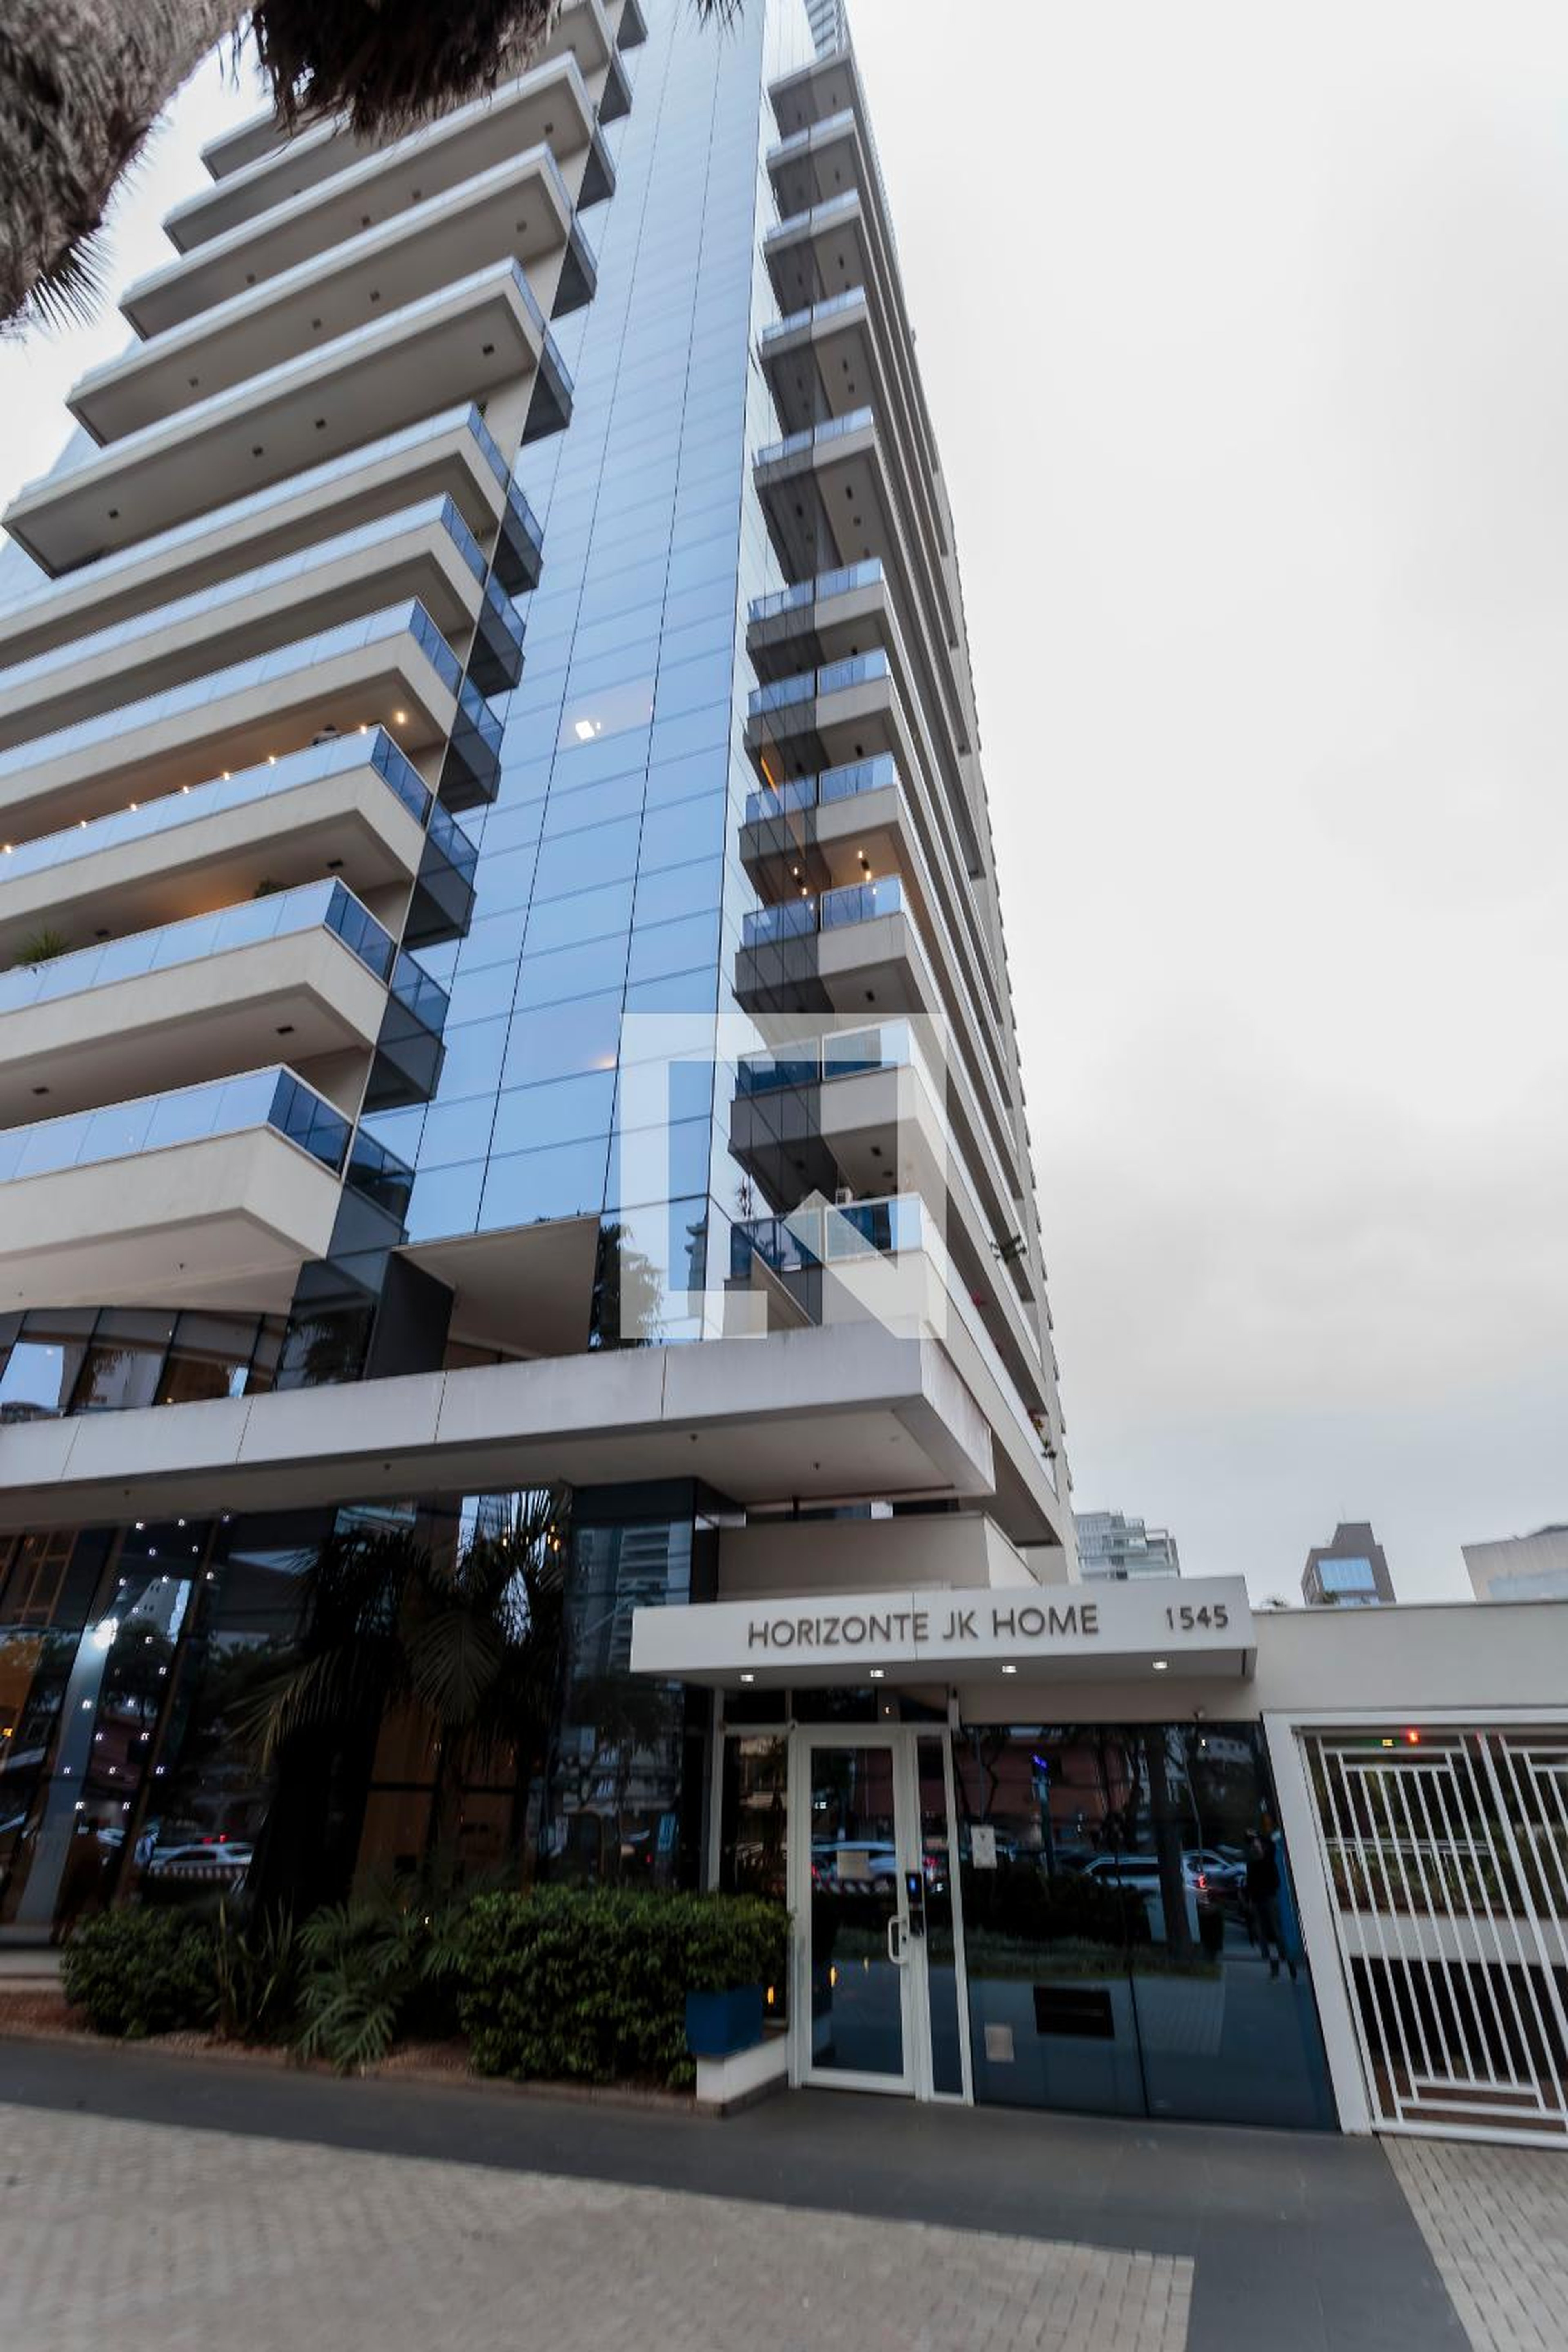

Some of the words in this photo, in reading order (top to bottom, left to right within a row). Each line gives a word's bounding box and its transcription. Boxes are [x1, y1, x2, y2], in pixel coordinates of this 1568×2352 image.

[747, 1612, 930, 1650] HORIZONTE
[942, 1610, 979, 1642] JK
[991, 1603, 1100, 1639] HOME
[1165, 1604, 1229, 1632] 1545
